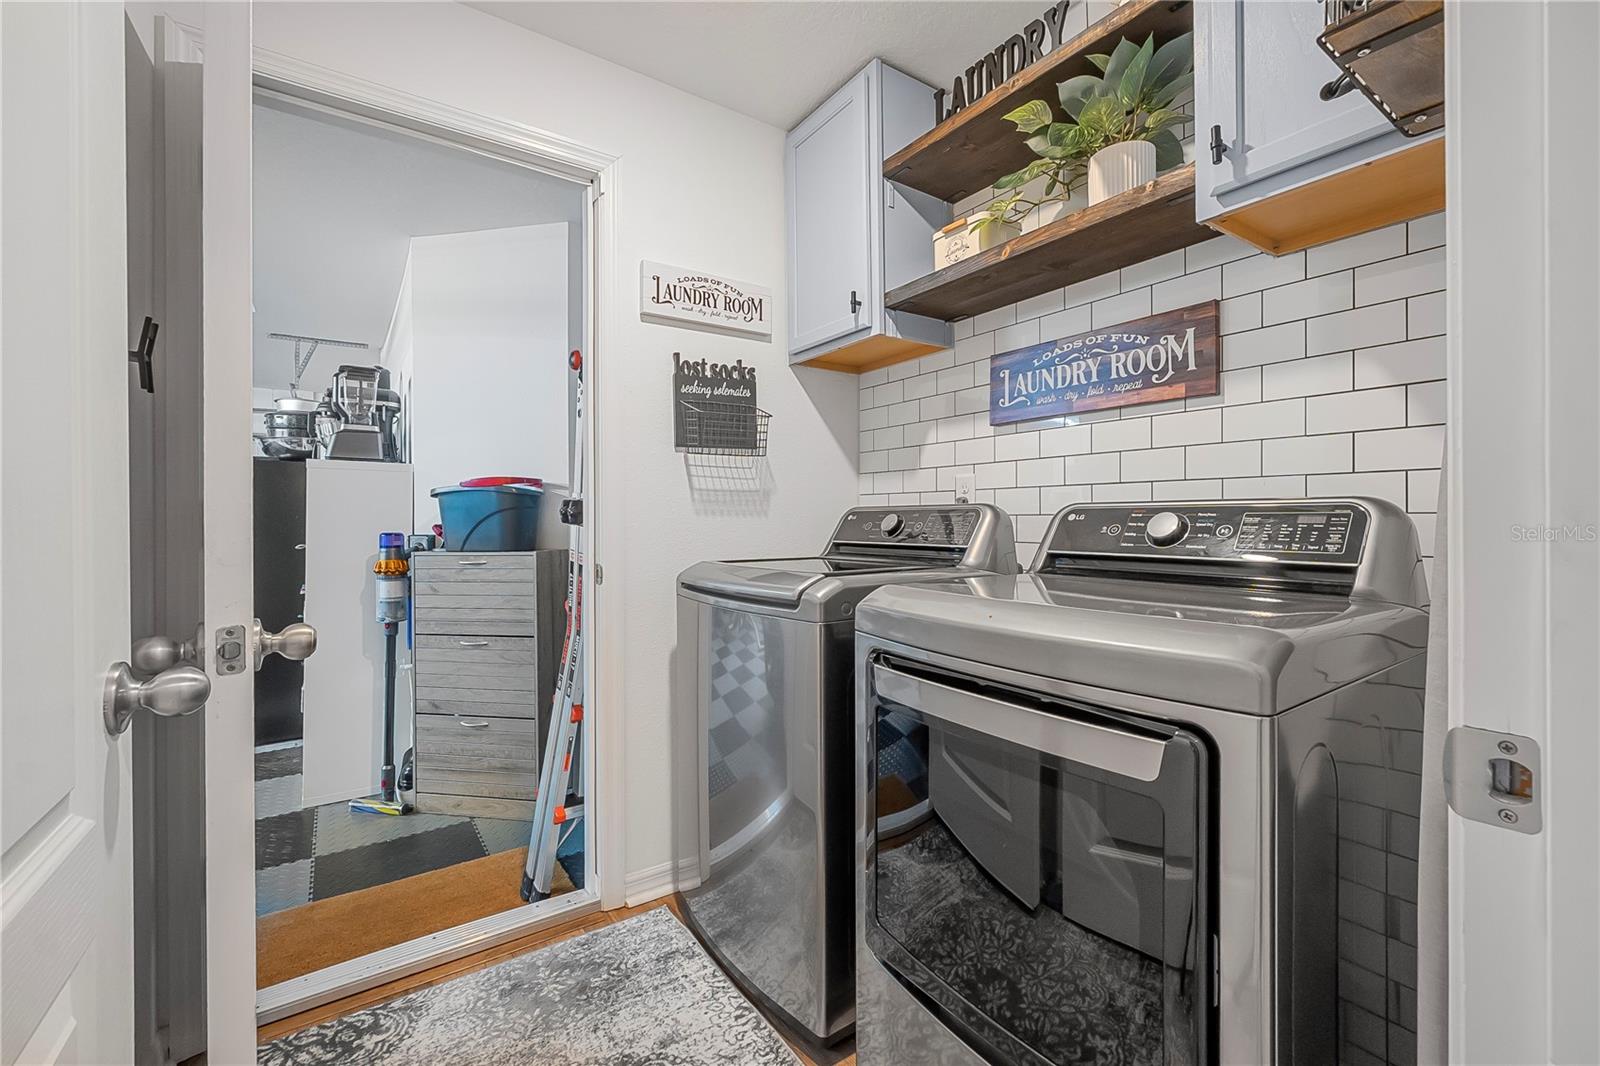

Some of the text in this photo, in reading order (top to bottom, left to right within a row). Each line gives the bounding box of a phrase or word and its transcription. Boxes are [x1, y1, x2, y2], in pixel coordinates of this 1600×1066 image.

[934, 0, 1069, 126] LAUNDRY
[651, 275, 763, 323] LAUNDRY ROOM
[677, 276, 744, 298] LOADS OF FUN
[1032, 333, 1150, 367] LOADS OF FUN
[673, 352, 757, 381] lost socks
[999, 327, 1198, 408] LAUNDRY ROOM
[680, 380, 752, 399] seeking solemates
[1064, 389, 1079, 402] dry
[1087, 384, 1105, 399] fold
[1112, 379, 1144, 394] repeat
